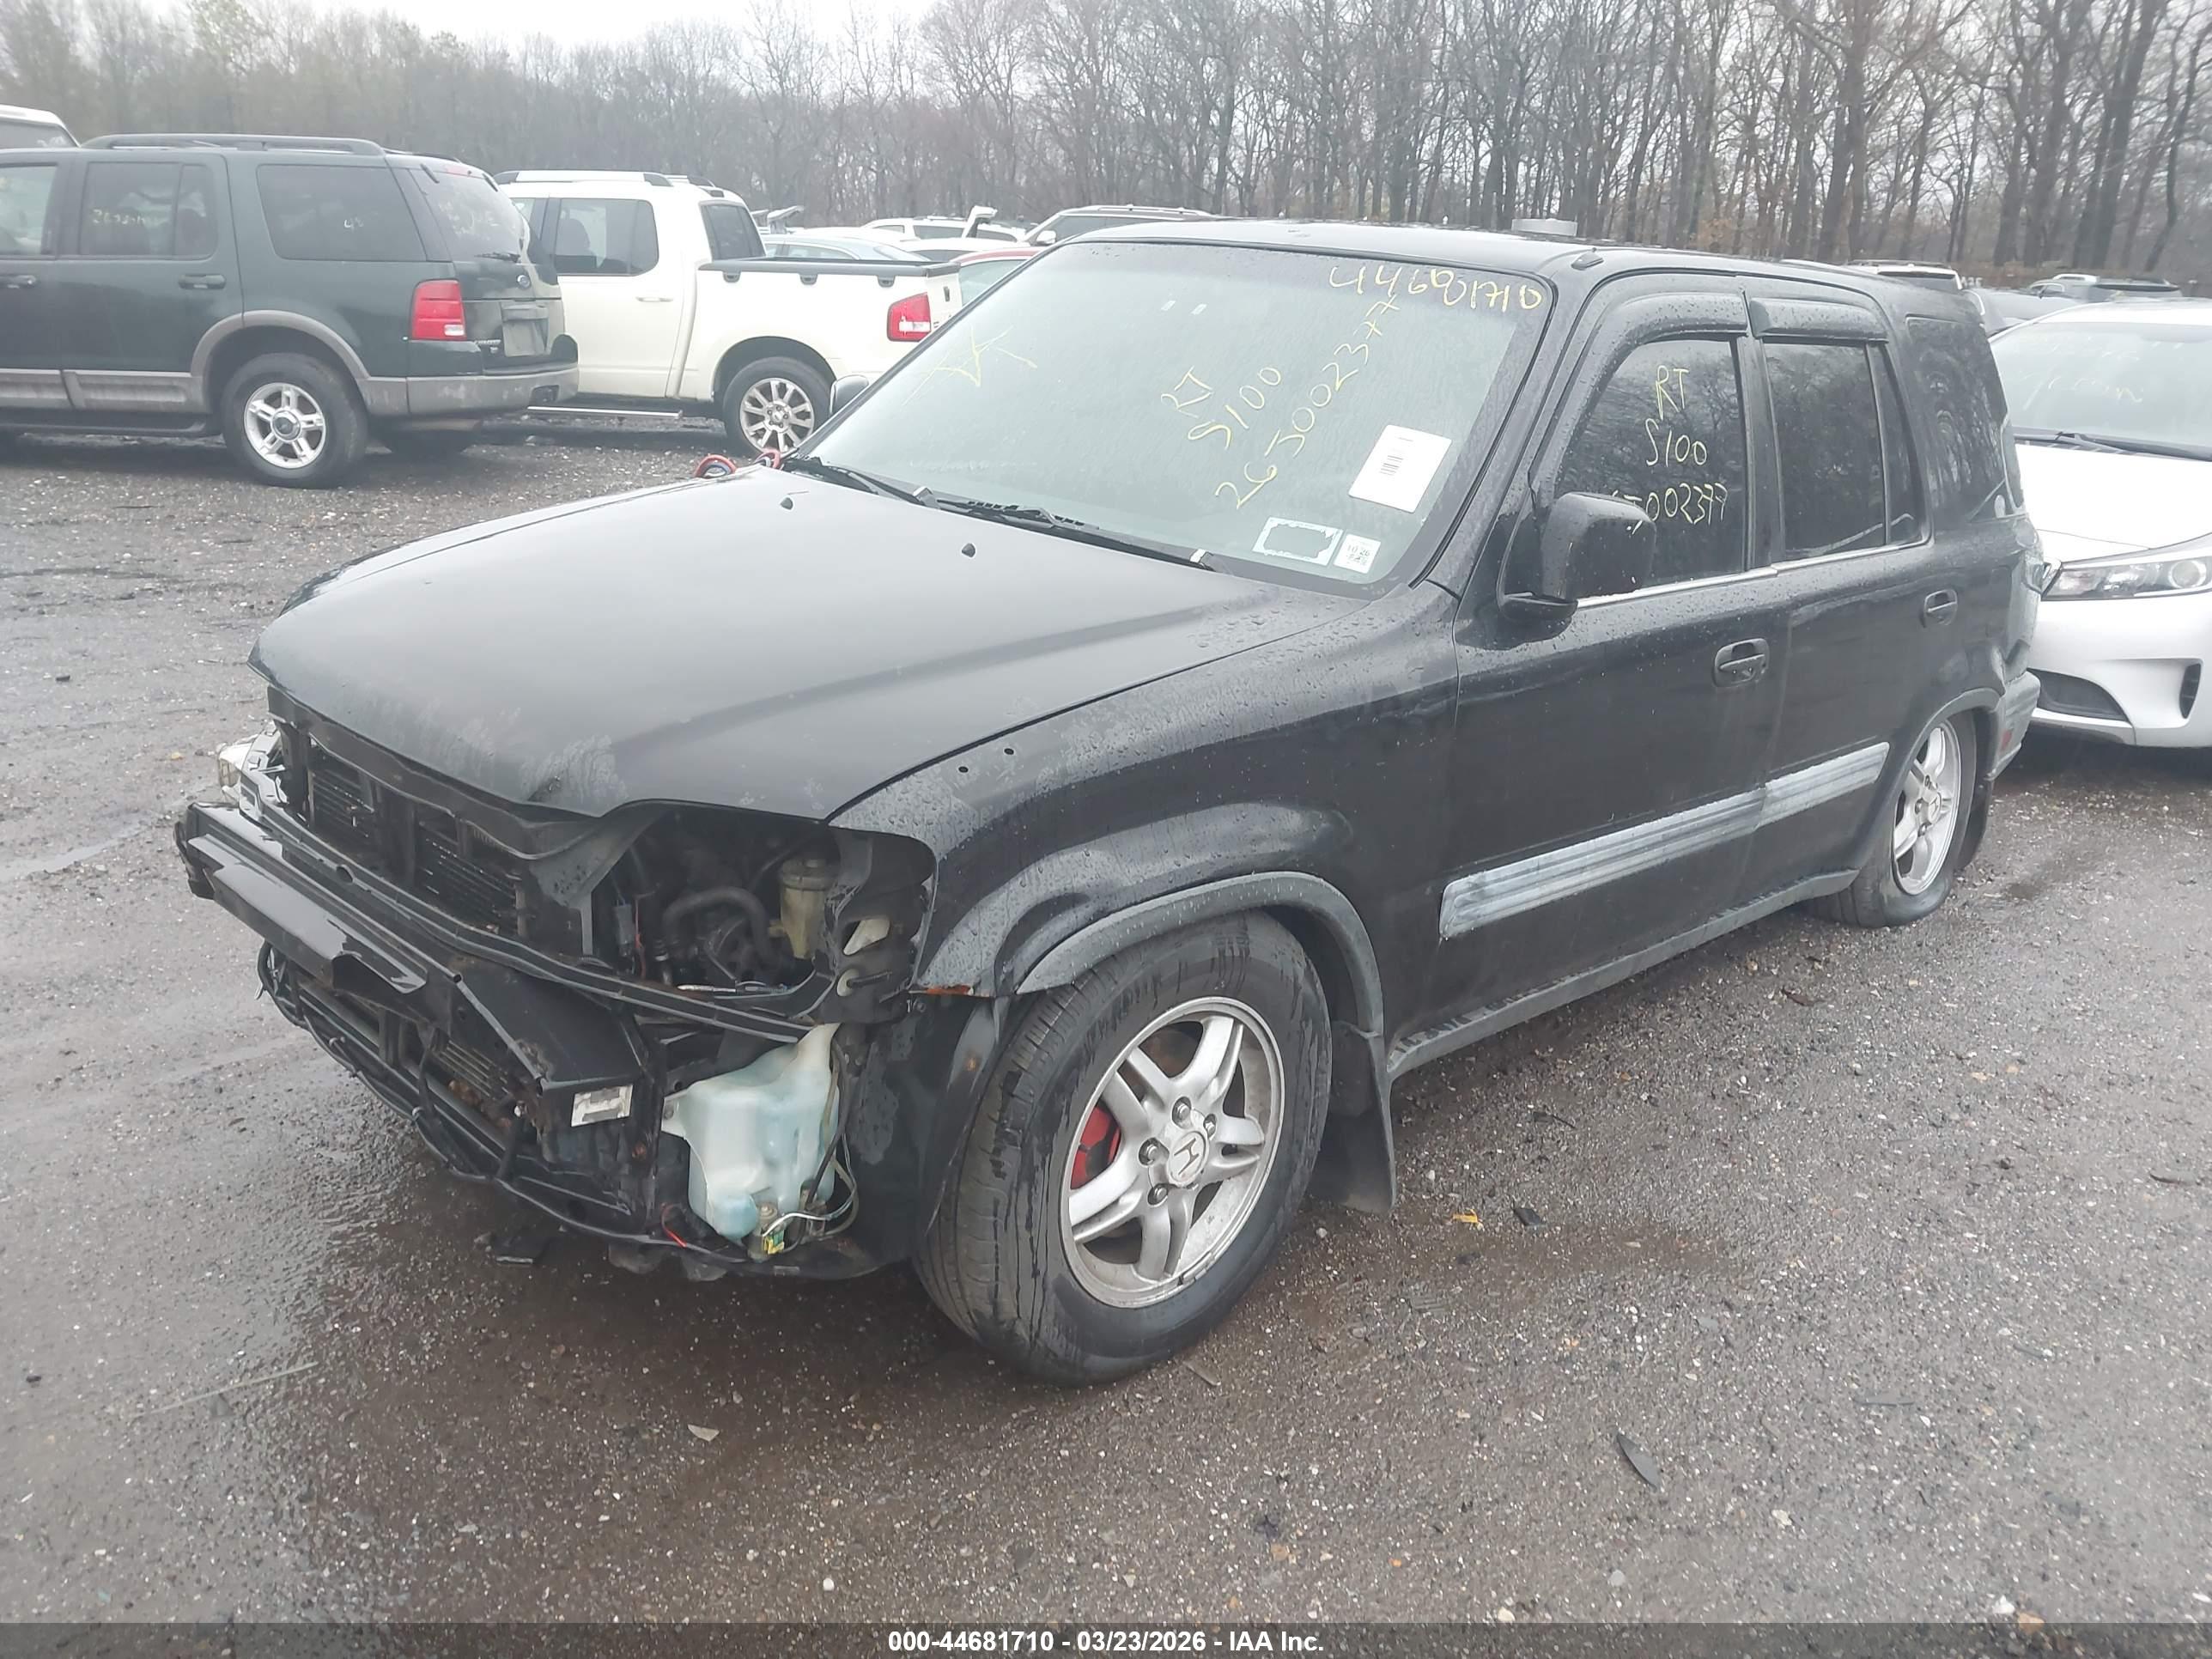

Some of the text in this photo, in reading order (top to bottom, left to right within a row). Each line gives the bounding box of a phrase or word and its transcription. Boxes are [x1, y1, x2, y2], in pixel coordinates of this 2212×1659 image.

[1328, 264, 1543, 313] 44681710
[1160, 365, 1214, 419] RT
[1655, 364, 1690, 421] RT
